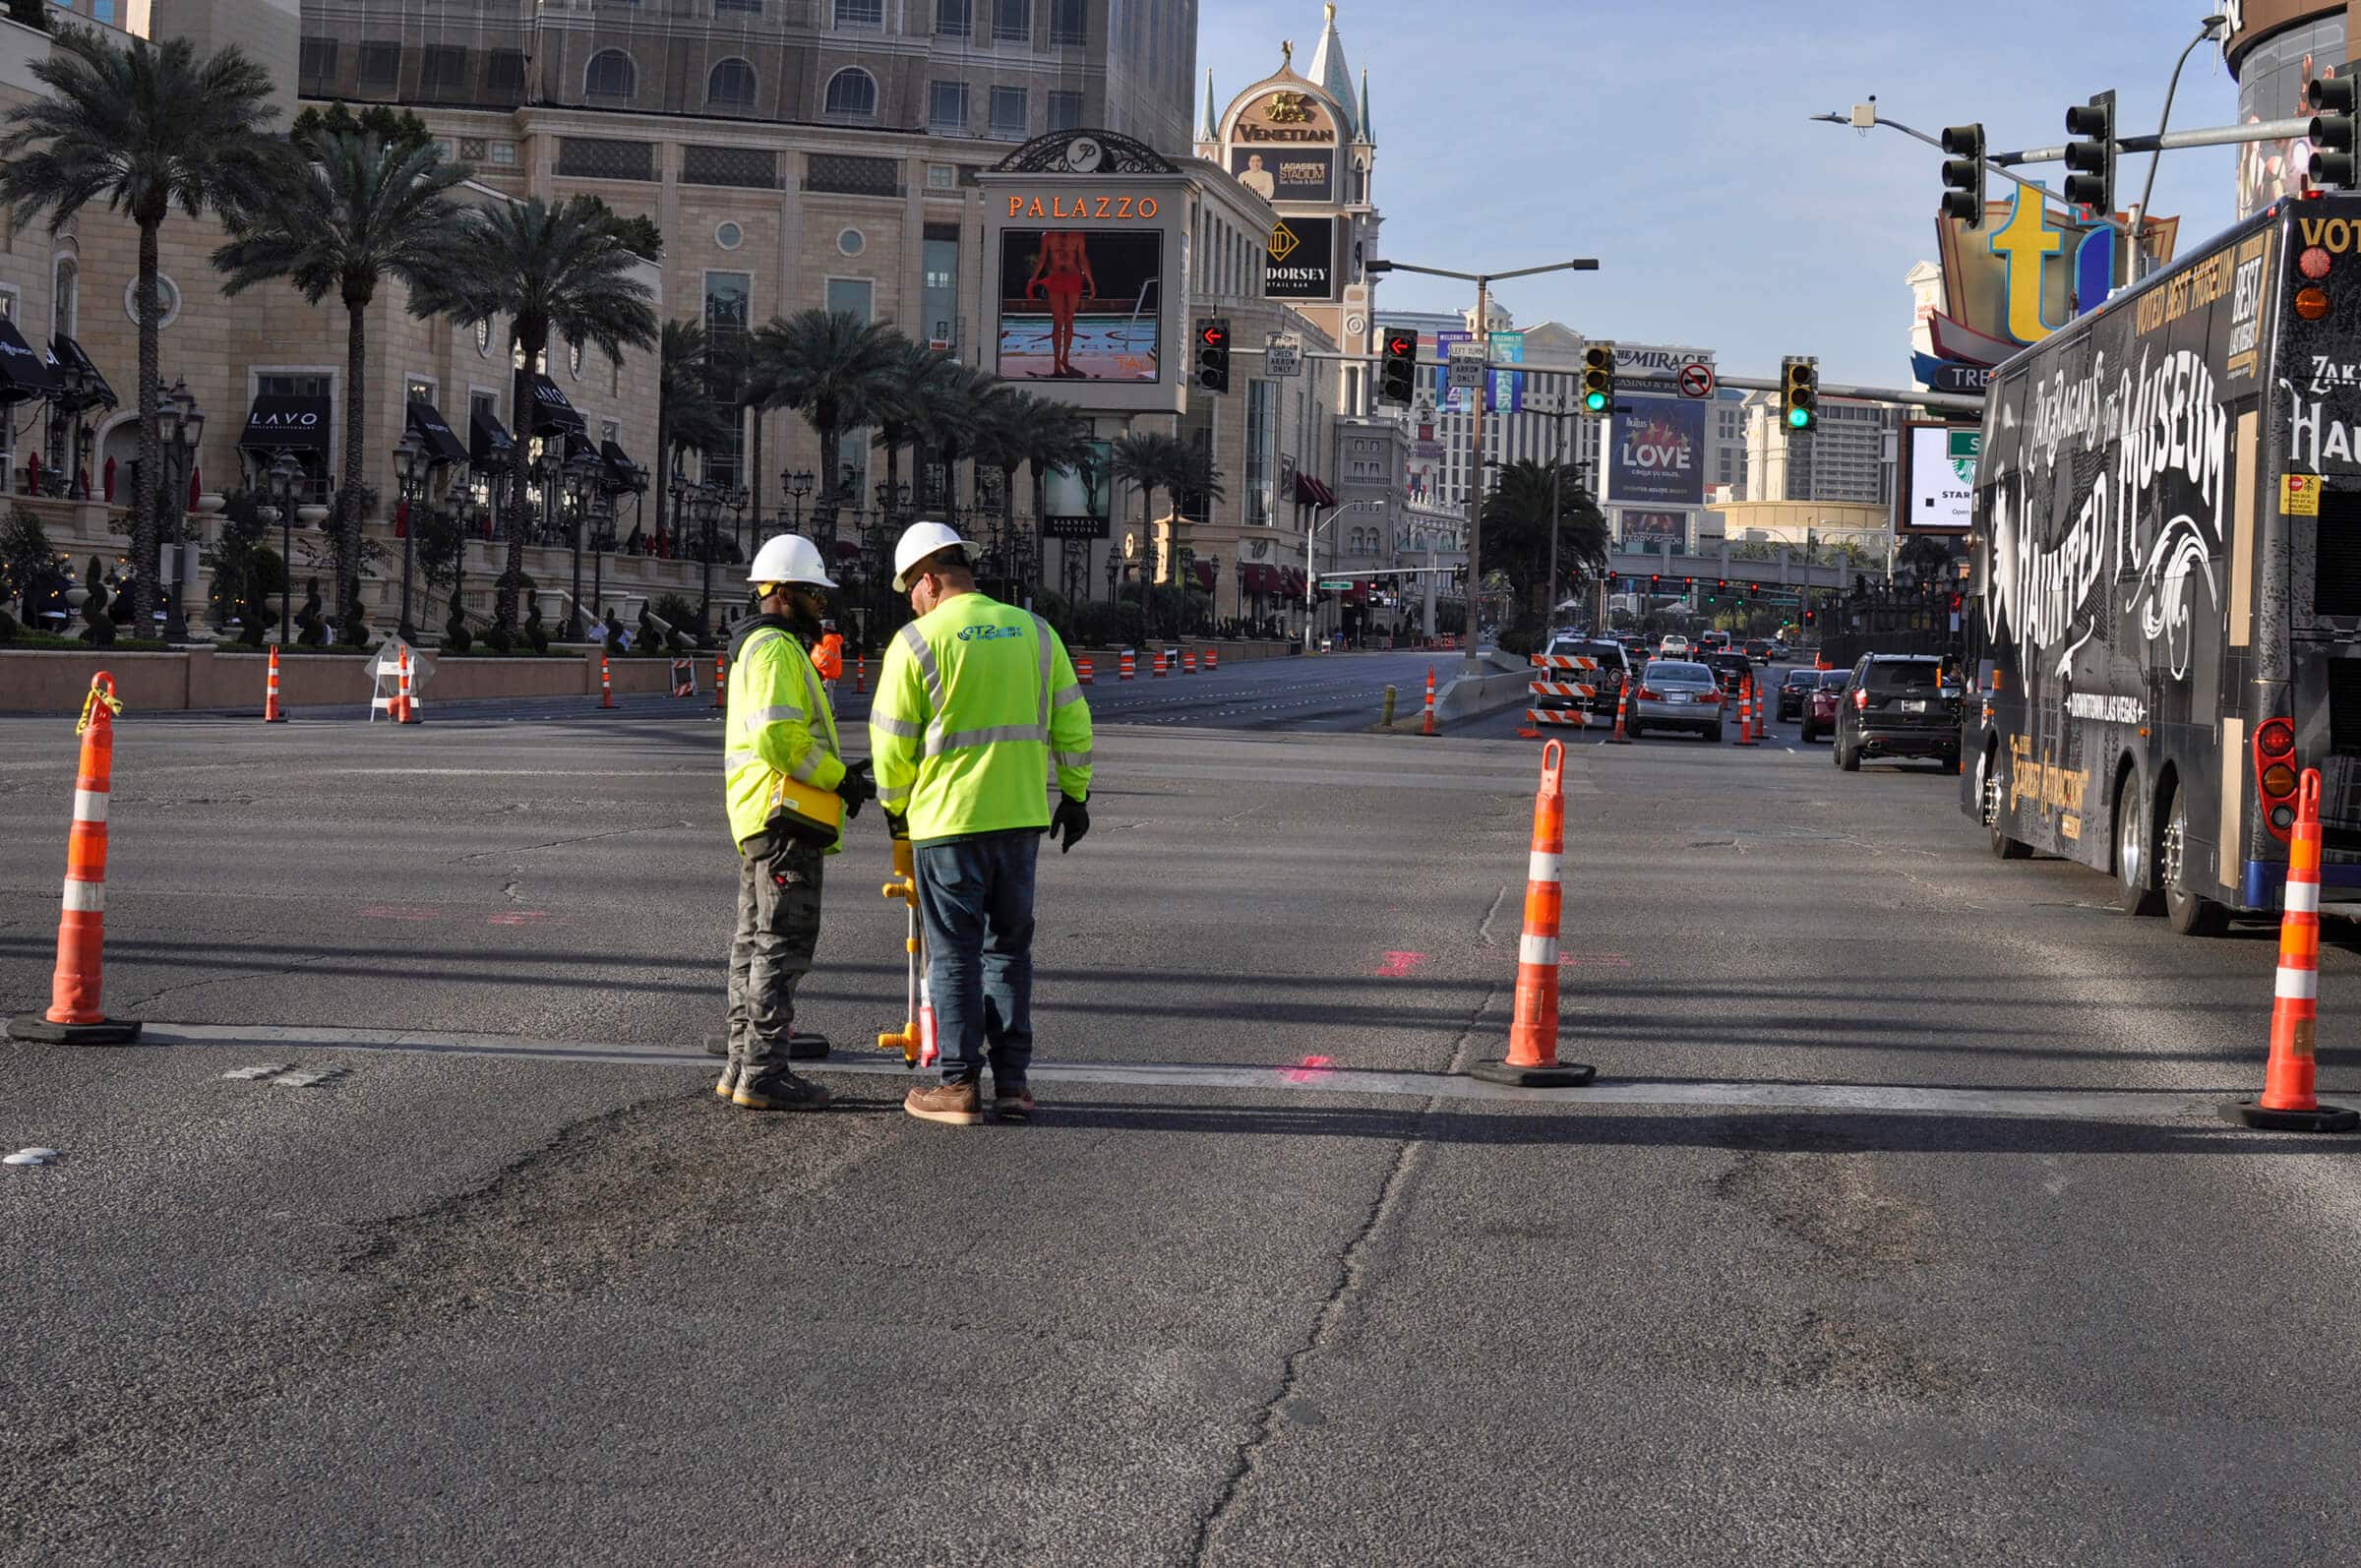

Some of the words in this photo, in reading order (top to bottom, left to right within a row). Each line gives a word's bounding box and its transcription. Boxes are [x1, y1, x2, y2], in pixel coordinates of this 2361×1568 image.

[1235, 123, 1335, 143] VENETIAN
[1279, 169, 1325, 180] STADIUM
[1008, 196, 1159, 218] PALAZZO
[1266, 267, 1328, 281] DORSEY
[2231, 256, 2263, 325] BEST
[2136, 283, 2166, 337] VOTED
[1615, 349, 1633, 360] HE
[251, 412, 318, 425] LAVO
[1623, 443, 1692, 469] LOVE
[2015, 446, 2107, 698] HAUNTED
[2114, 342, 2227, 586] MUSEUM
[2072, 692, 2104, 719] DOWNTOWN
[2105, 694, 2116, 722] LAS
[2116, 695, 2138, 725] VEGAS
